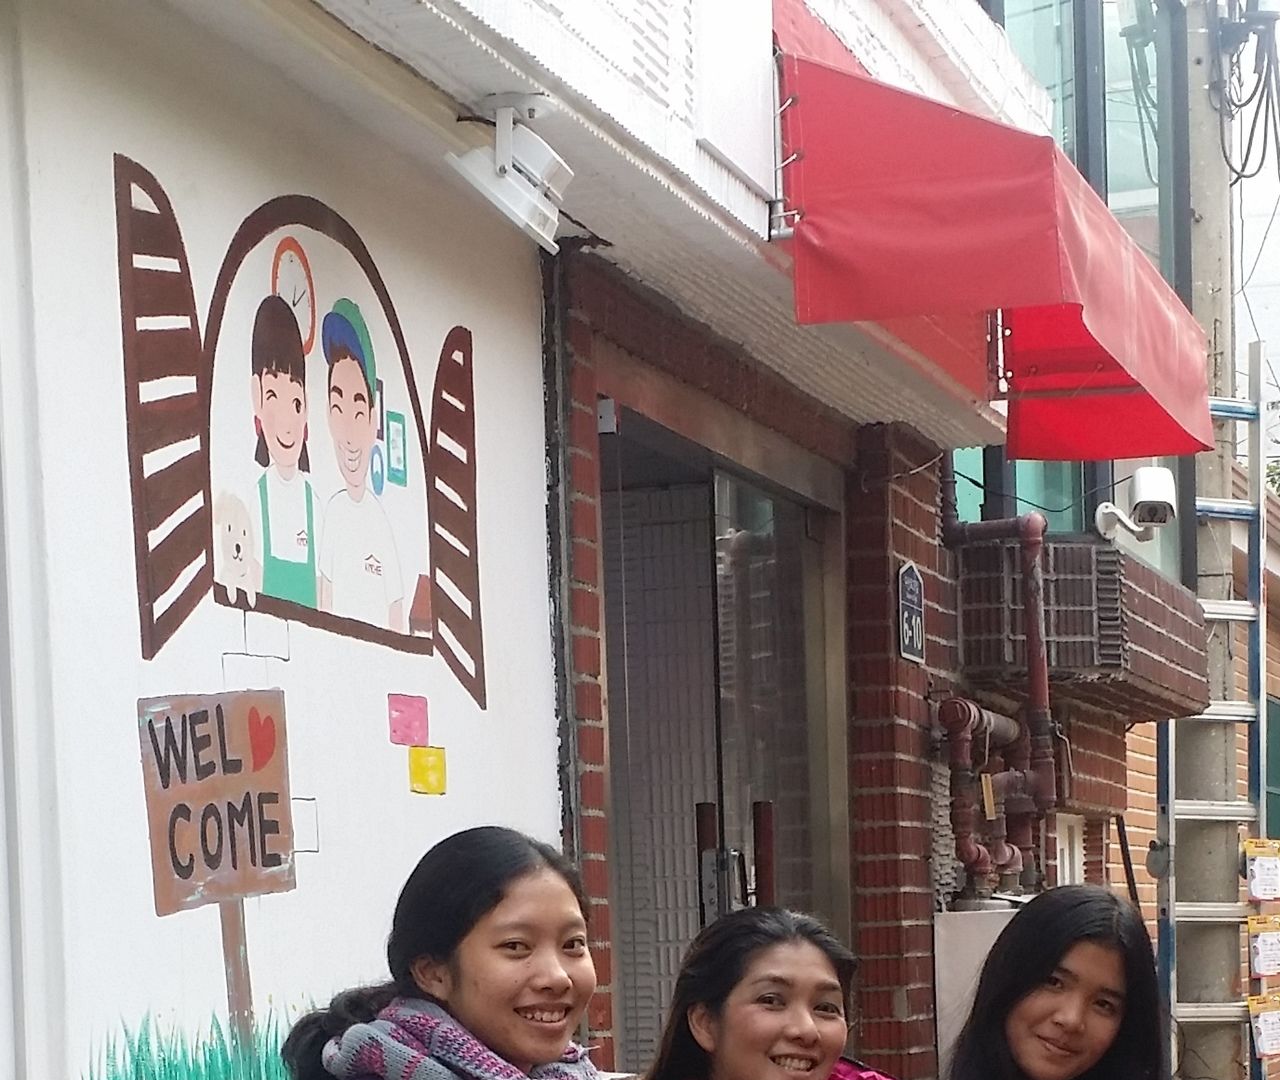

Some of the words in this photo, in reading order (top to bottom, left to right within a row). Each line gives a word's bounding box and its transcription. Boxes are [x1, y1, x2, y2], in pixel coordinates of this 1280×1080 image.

[903, 611, 922, 650] 6-10
[148, 703, 243, 790] WEL
[168, 791, 283, 881] COME
